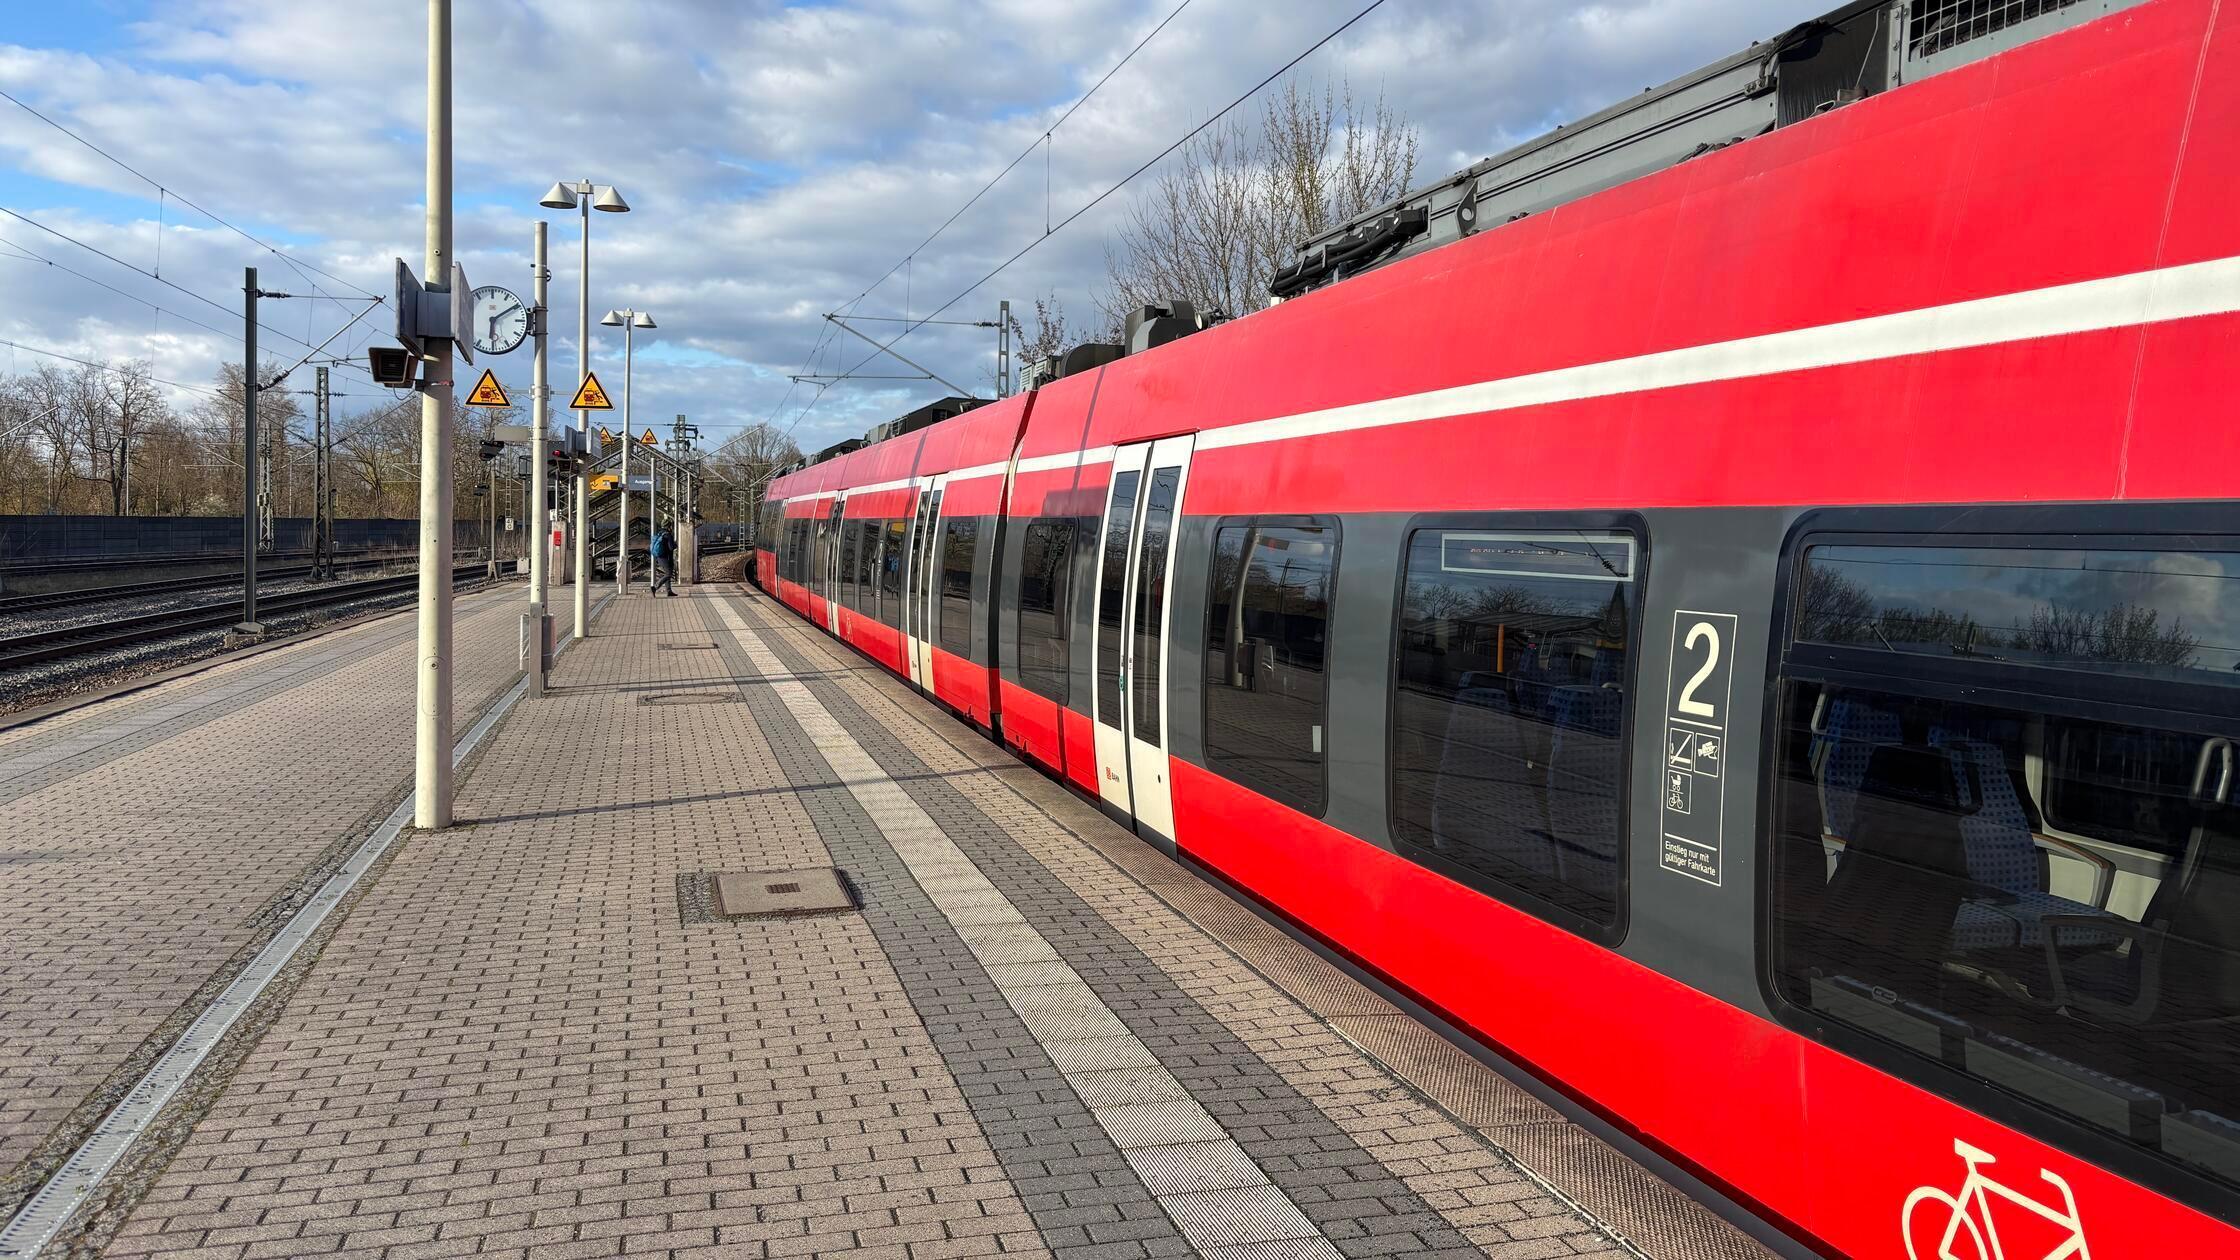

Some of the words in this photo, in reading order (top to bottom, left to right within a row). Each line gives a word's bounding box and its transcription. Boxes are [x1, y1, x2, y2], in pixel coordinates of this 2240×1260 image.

[1678, 622, 1720, 718] 2
[1665, 840, 1688, 858] Einstieg
[1688, 850, 1699, 859] nur
[1699, 853, 1710, 863] mit
[1664, 852, 1687, 867] gültiger
[1687, 859, 1716, 876] Fahrkarte
